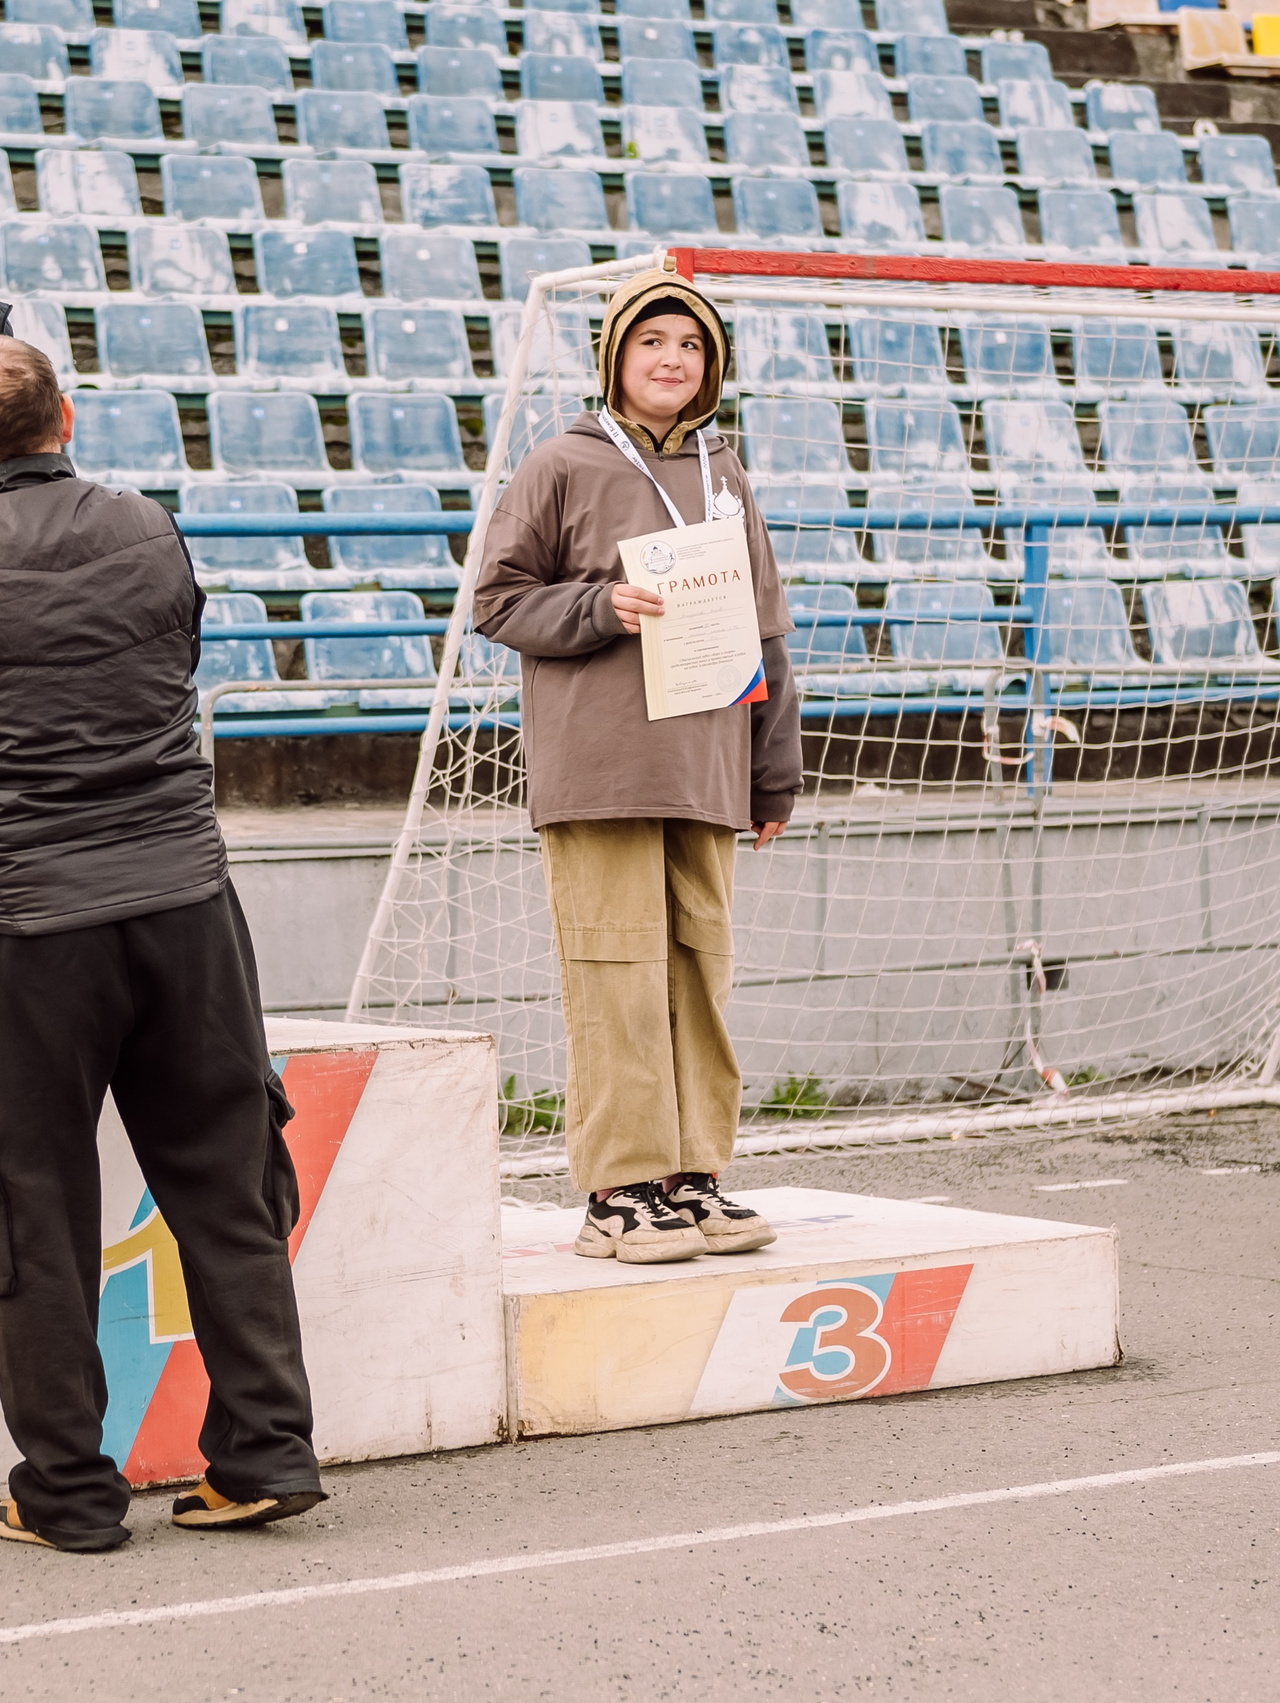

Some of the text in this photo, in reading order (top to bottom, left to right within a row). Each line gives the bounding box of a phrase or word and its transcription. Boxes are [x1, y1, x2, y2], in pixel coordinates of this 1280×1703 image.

[657, 569, 741, 594] ГРАМОТА
[677, 595, 727, 608] НАГРАЖДАЕТСЯ
[779, 1283, 892, 1400] 3
